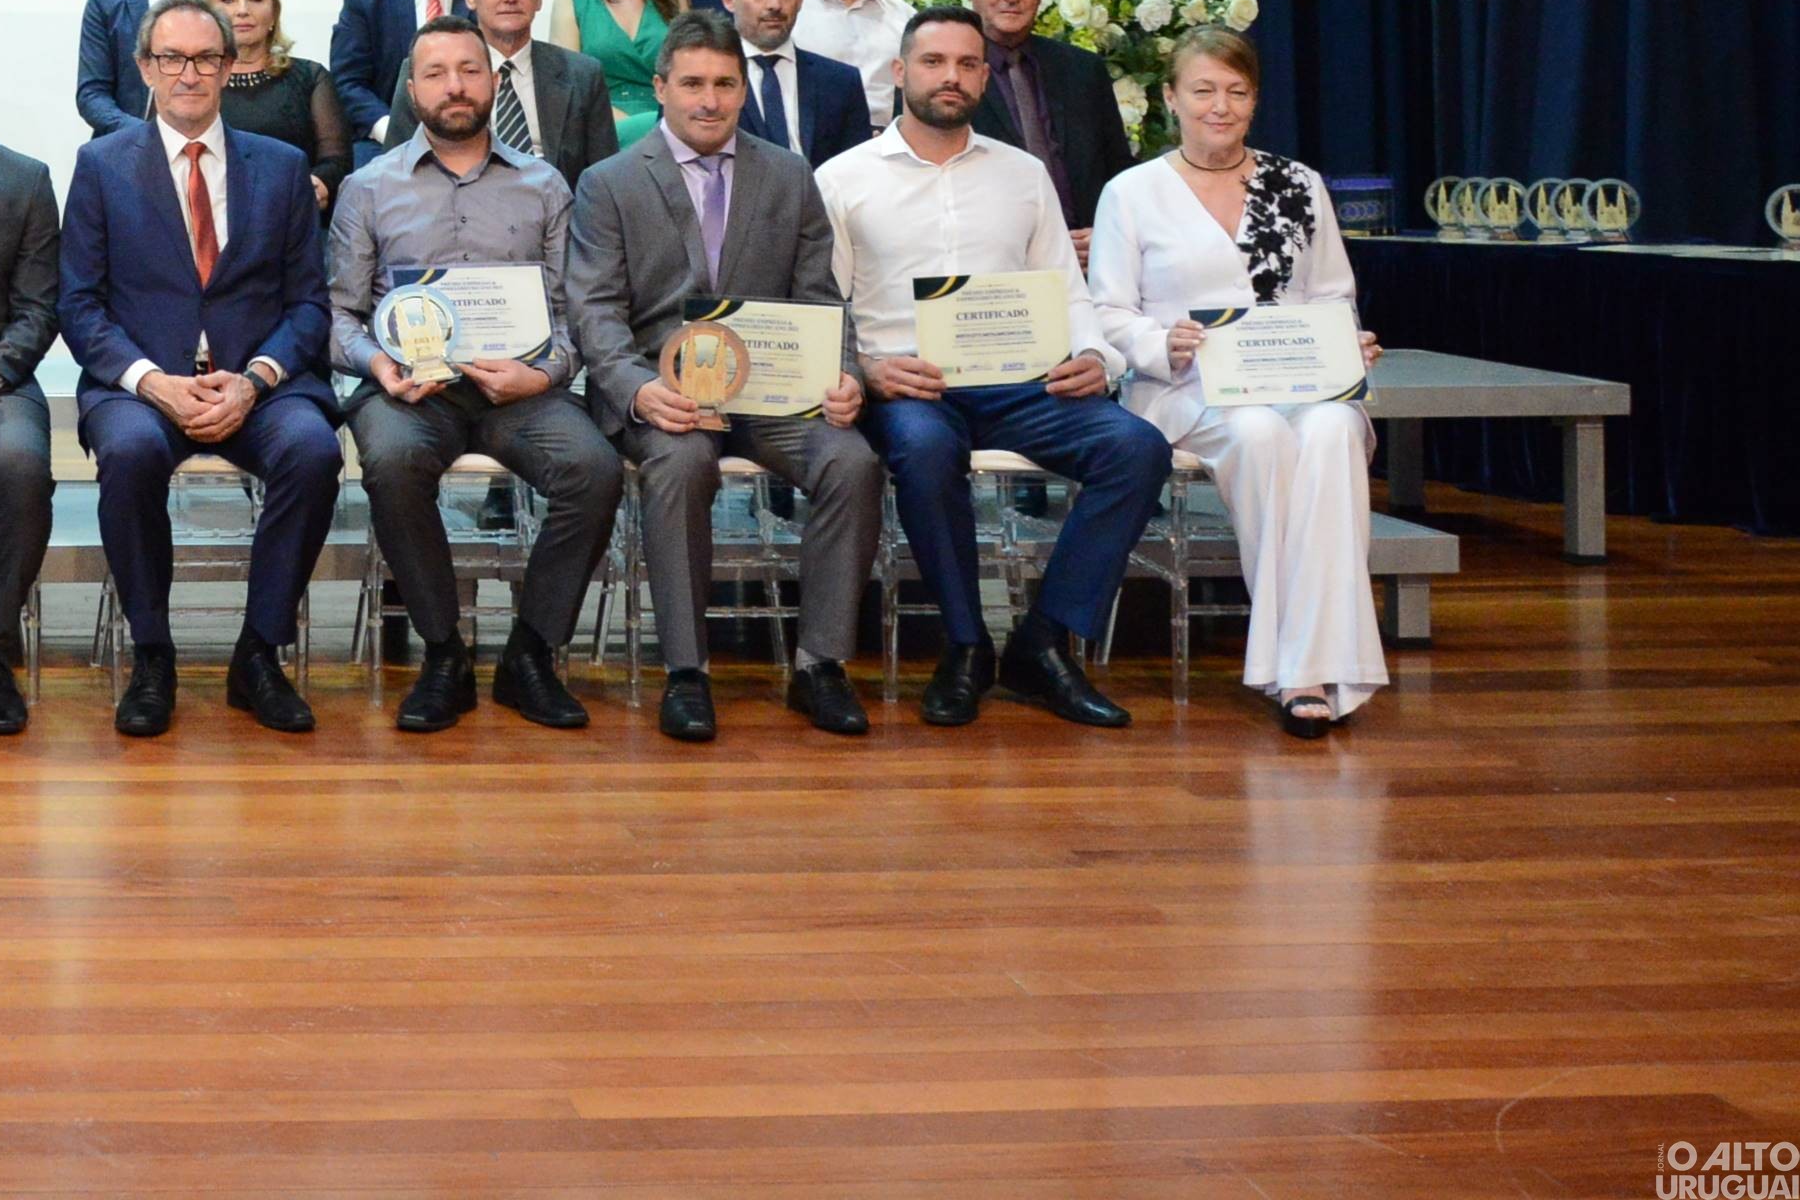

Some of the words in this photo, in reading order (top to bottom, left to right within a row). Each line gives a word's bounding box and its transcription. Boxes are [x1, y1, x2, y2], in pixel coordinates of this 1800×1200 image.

[956, 308, 1029, 321] CERTIFICADO
[744, 340, 800, 351] TIFICADO
[1237, 336, 1315, 348] CERTIFICADO
